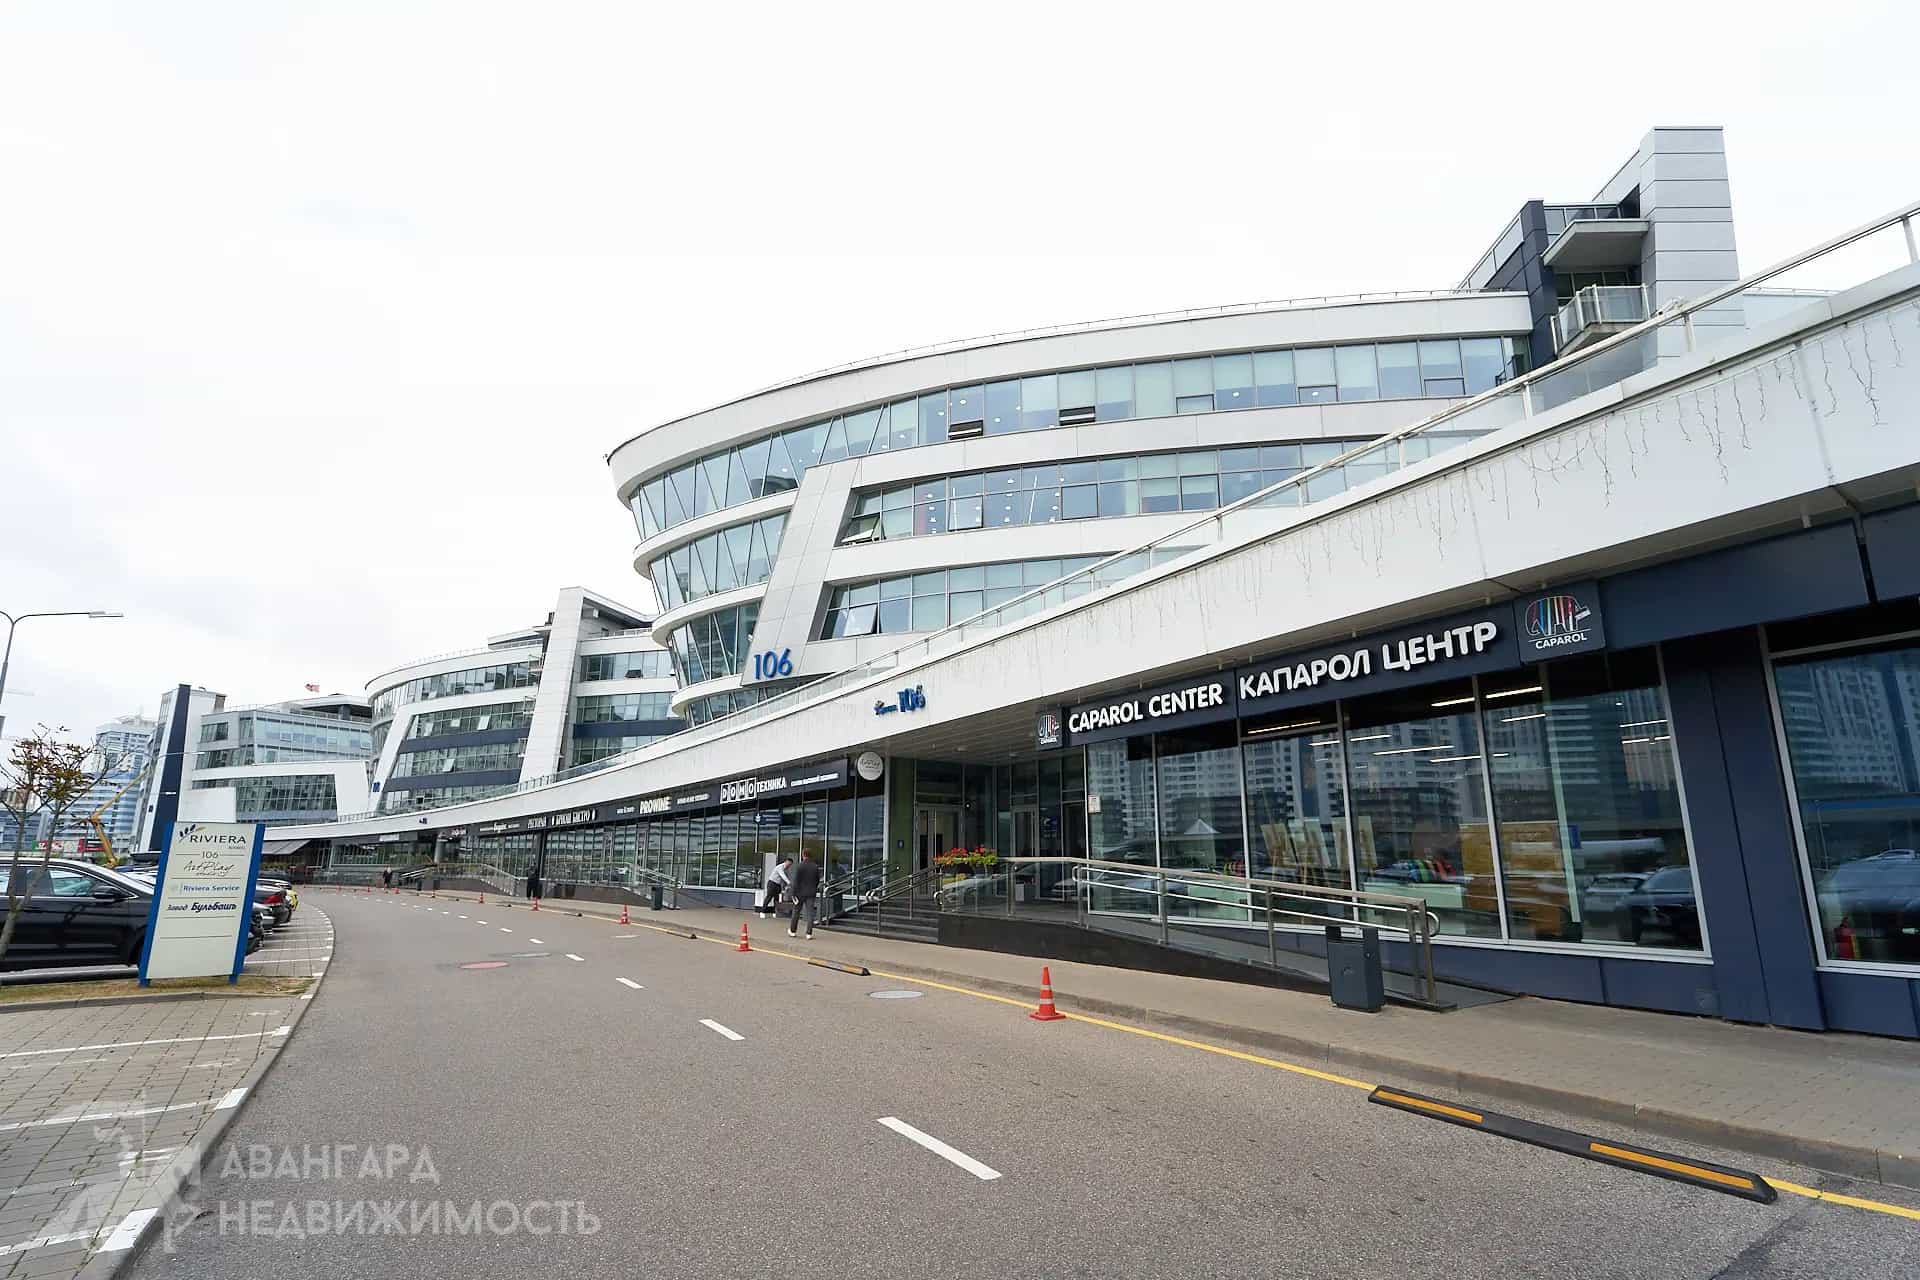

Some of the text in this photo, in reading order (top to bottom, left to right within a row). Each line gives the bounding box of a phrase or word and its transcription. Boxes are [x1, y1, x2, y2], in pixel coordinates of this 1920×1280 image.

[1535, 632, 1588, 649] CAPAROL
[753, 647, 793, 681] 106
[1239, 621, 1497, 700] КАПАРОЛ ЦЕНТР
[897, 684, 927, 713] 106
[1068, 682, 1224, 733] CAPAROL CENTER
[189, 834, 247, 844] RIVIERA
[202, 851, 219, 859] 106
[211, 884, 240, 892] Service
